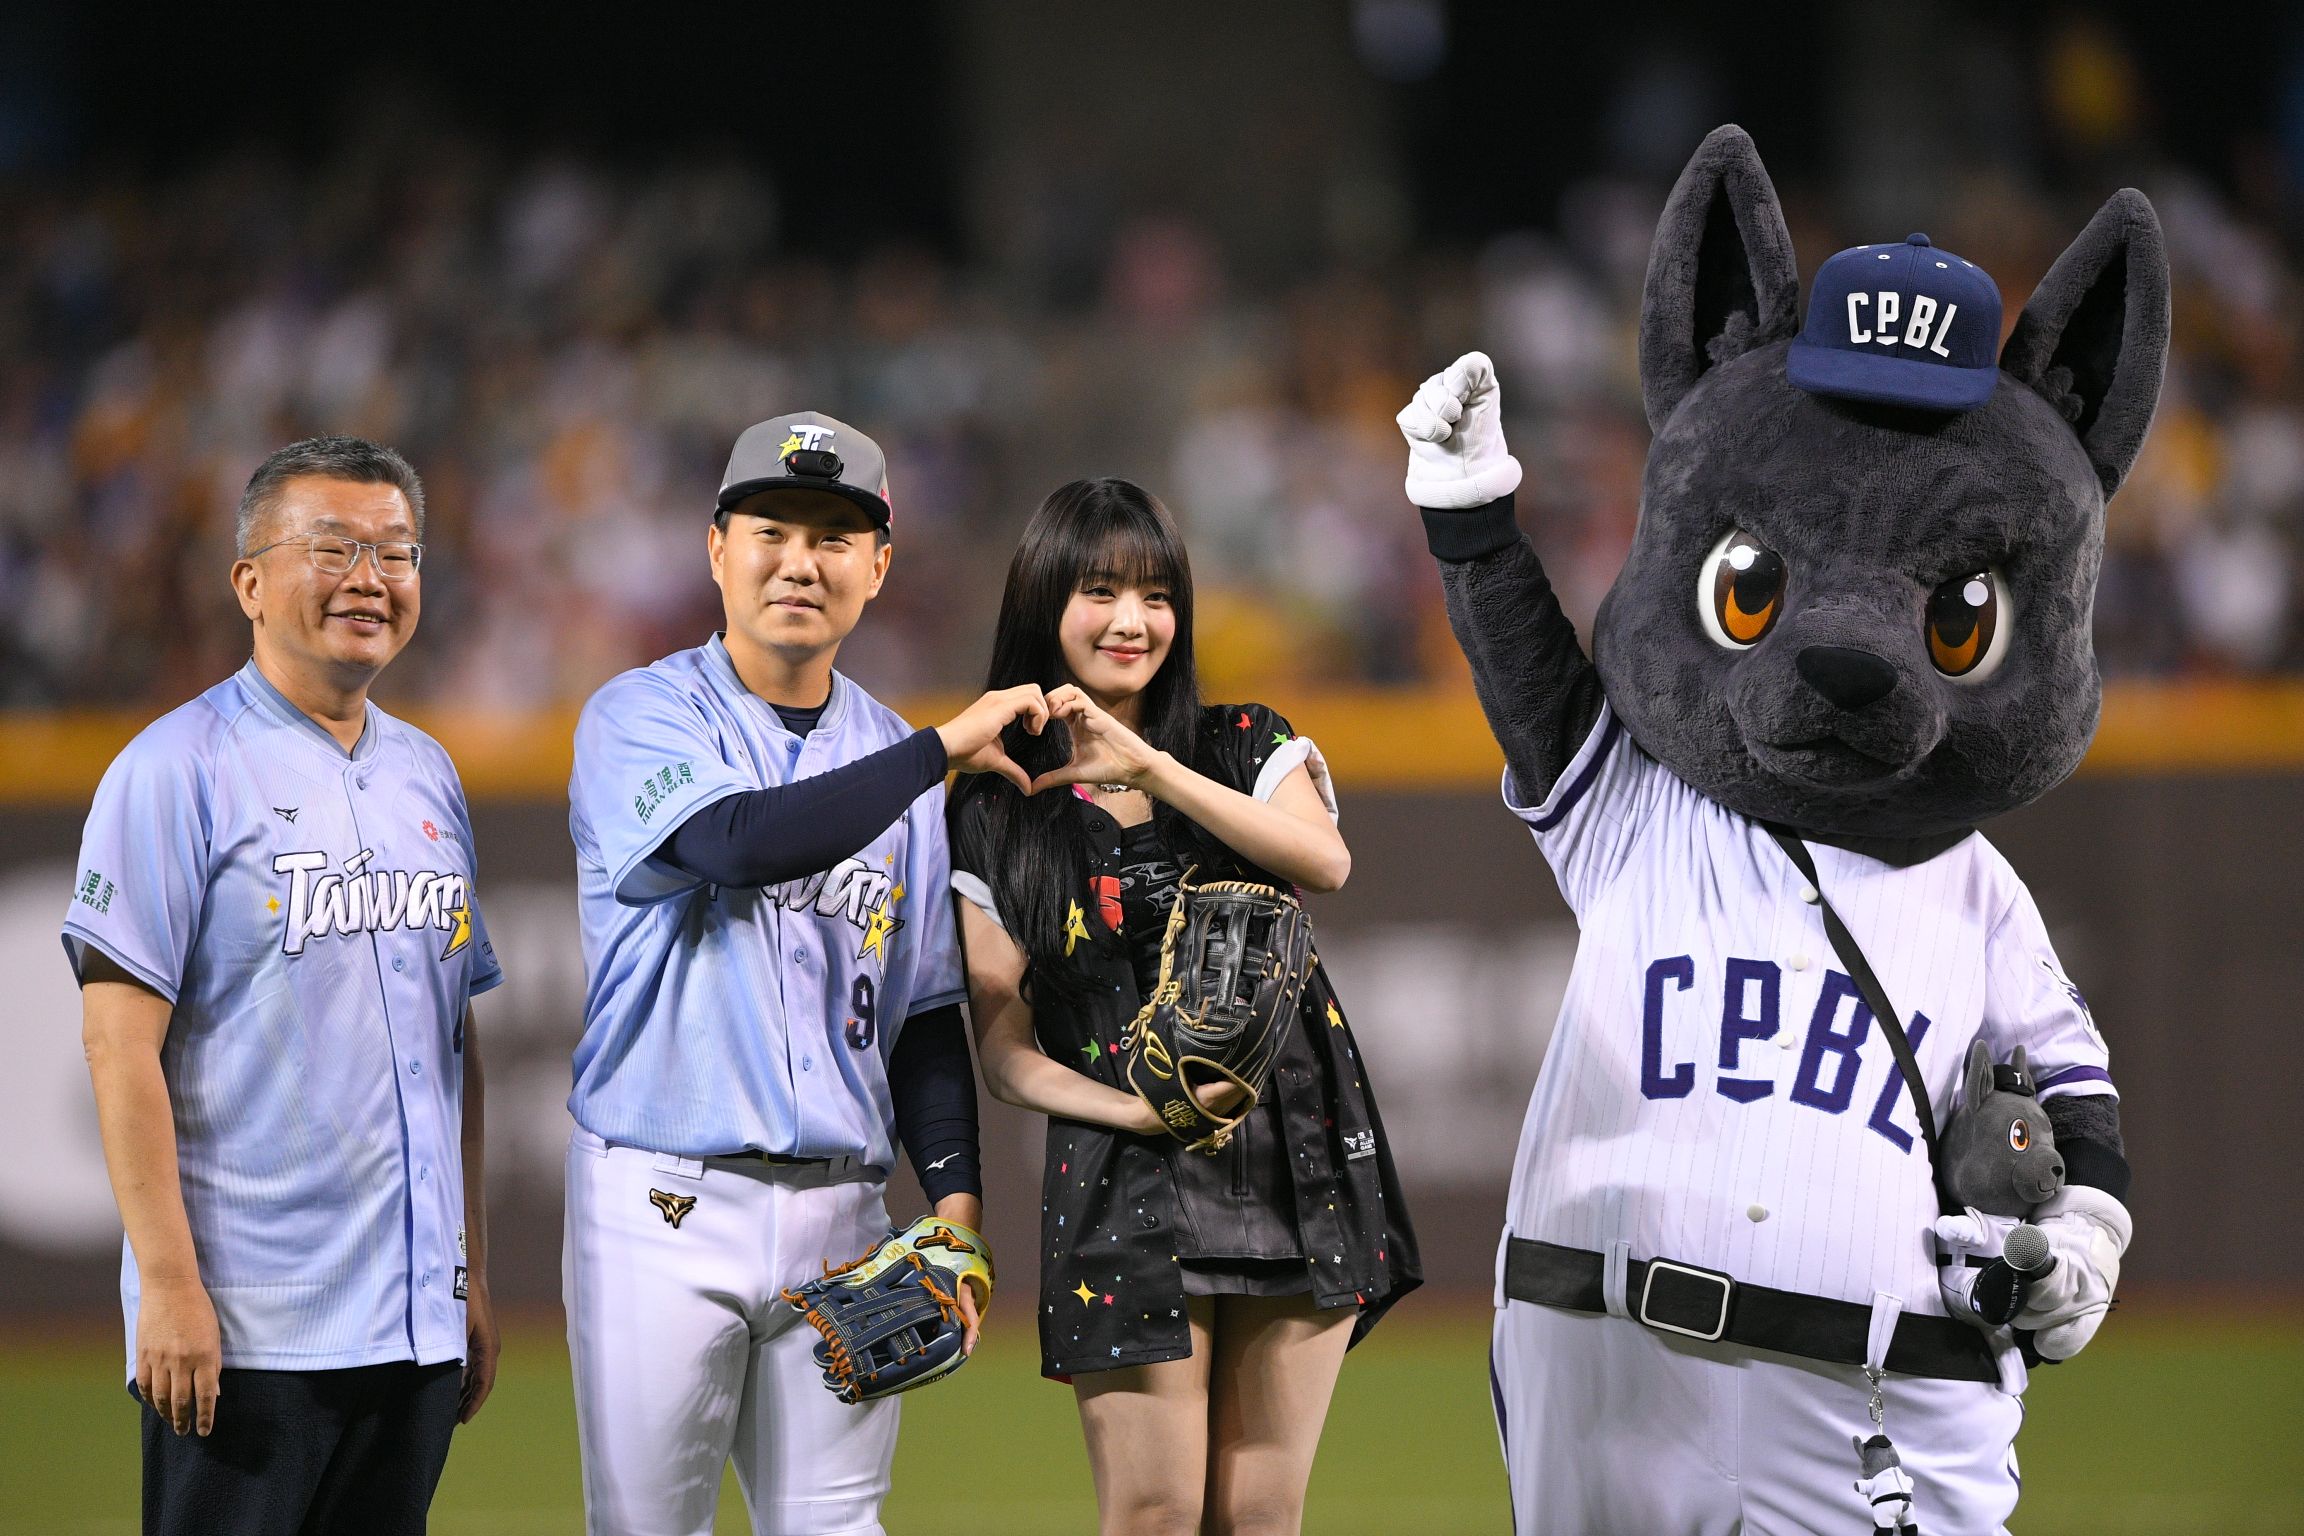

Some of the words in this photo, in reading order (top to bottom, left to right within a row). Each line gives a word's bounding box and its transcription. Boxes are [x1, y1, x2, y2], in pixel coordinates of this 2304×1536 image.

[1847, 291, 1957, 358] CPBL
[273, 848, 467, 956] Taiwan
[845, 972, 875, 1052] 9
[1641, 955, 1931, 1154] CPBL
